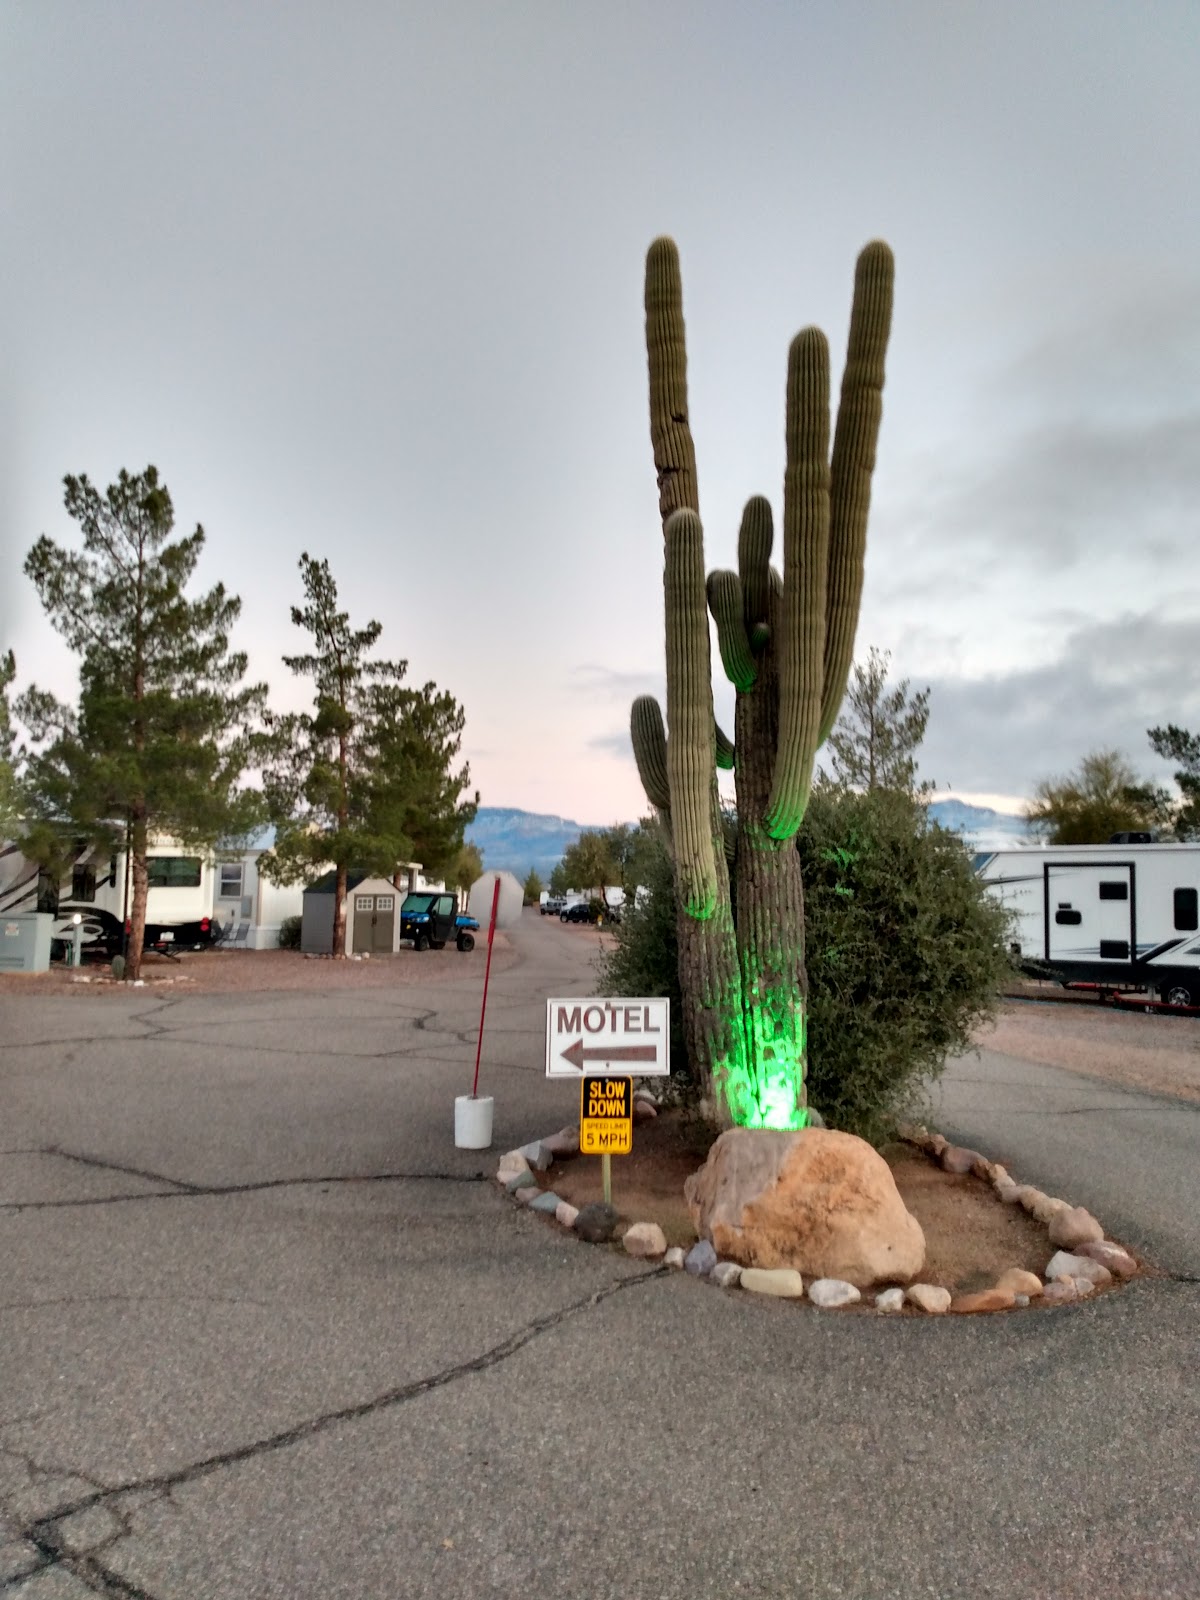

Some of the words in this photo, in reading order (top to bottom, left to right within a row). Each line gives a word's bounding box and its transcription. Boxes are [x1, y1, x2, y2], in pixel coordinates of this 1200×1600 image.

[557, 1006, 660, 1033] MOTEL
[589, 1081, 626, 1098] SLOW
[588, 1100, 625, 1116] DOWN
[586, 1122, 608, 1130] SPEED
[610, 1122, 628, 1130] LIMIT
[586, 1133, 595, 1146] 5
[599, 1132, 627, 1146] MPH
